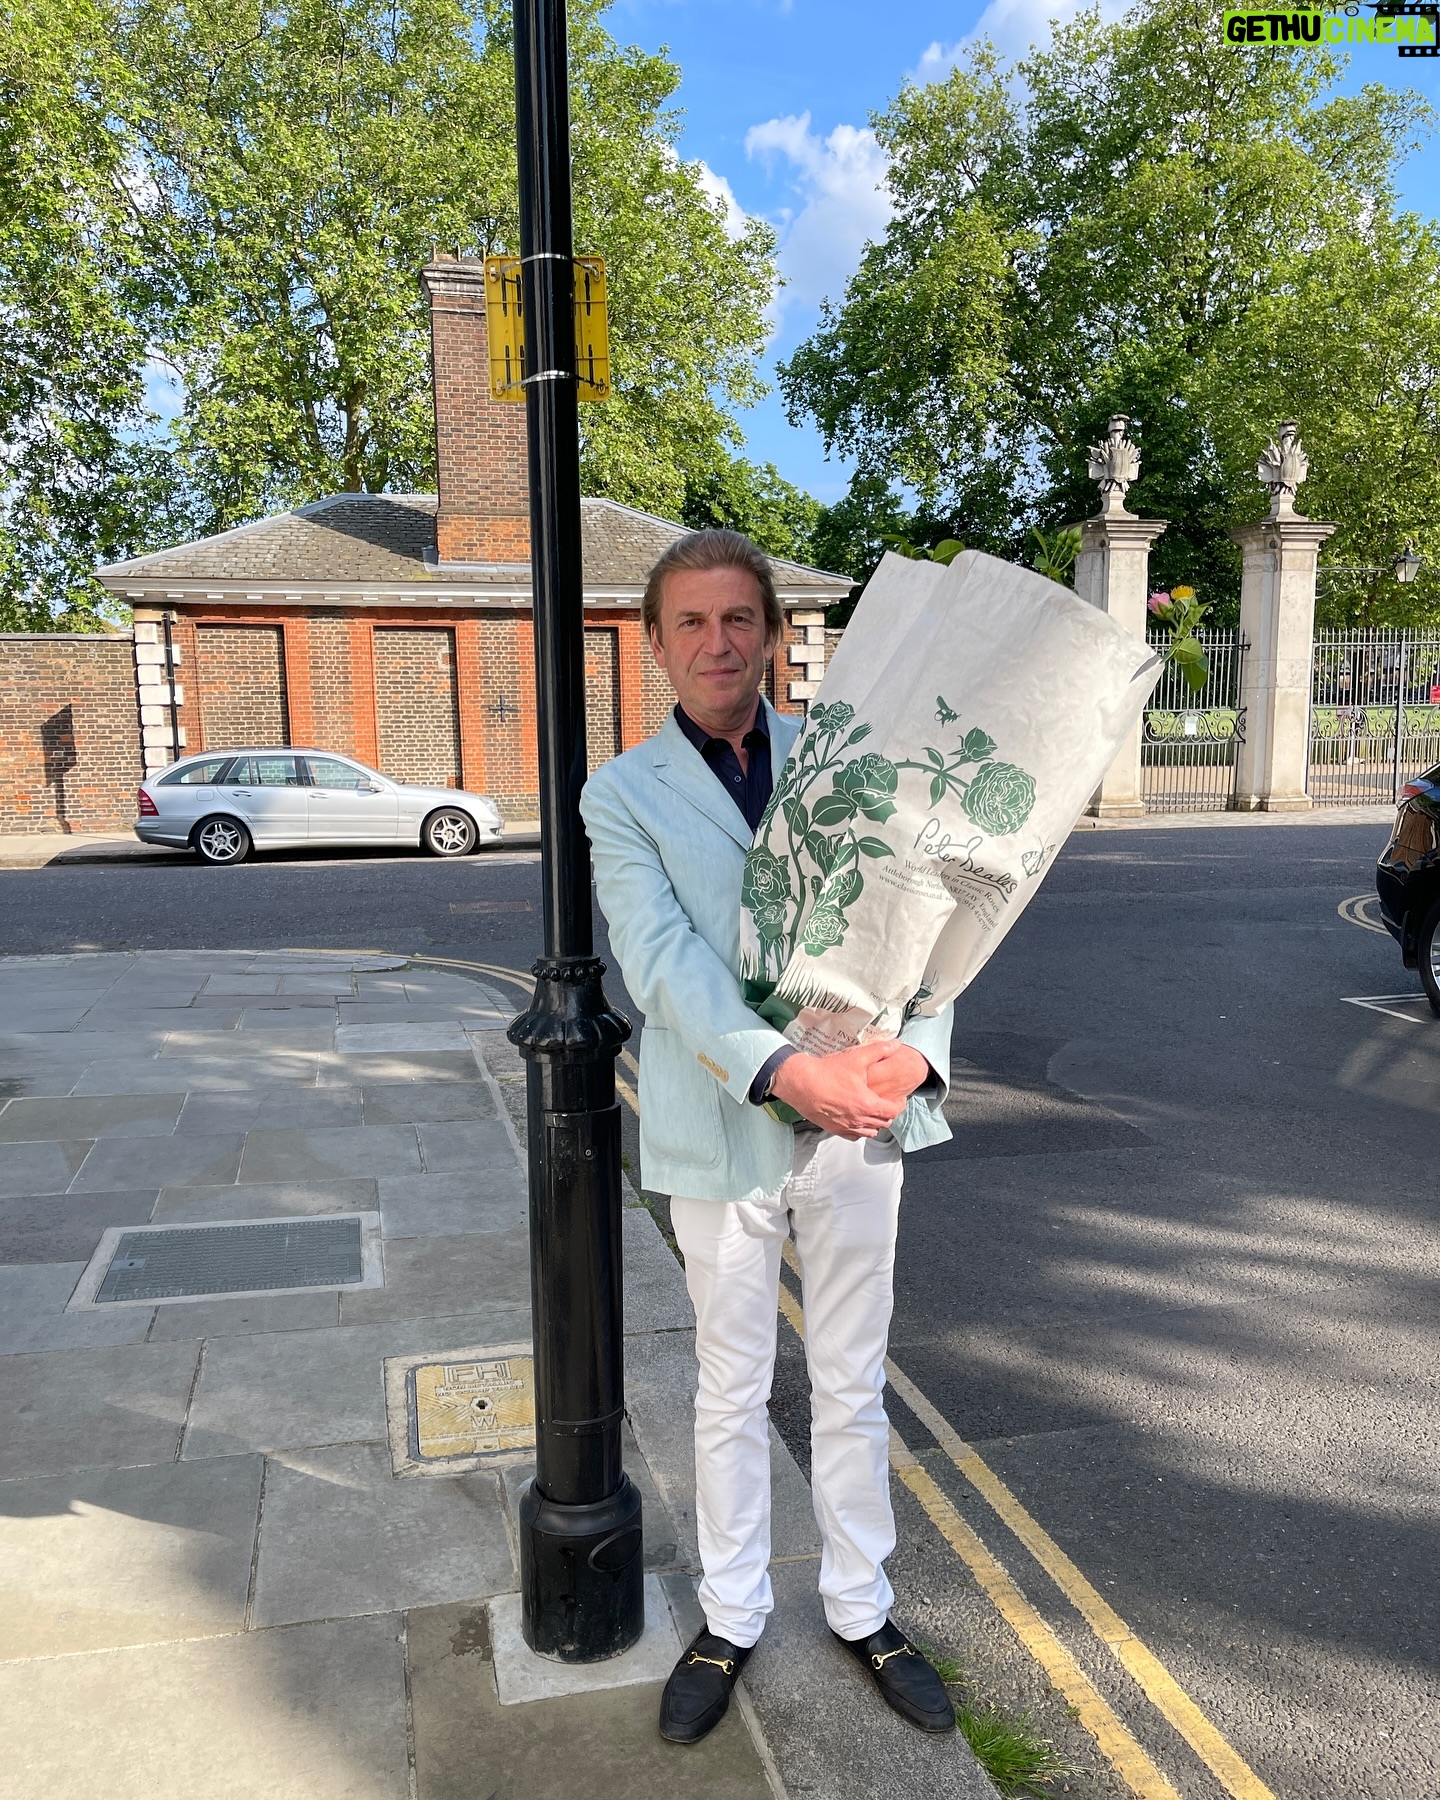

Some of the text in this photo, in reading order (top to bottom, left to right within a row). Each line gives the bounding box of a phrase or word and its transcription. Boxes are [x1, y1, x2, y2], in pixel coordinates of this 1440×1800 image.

[913, 817, 956, 863] Peter
[881, 864, 924, 887] Attleborough
[979, 902, 999, 929] England
[904, 859, 928, 874] World
[925, 867, 951, 881] Leaders
[960, 880, 985, 894] Classic
[984, 891, 1001, 914] Roses
[451, 1362, 505, 1383] FH
[470, 1412, 498, 1429] W
